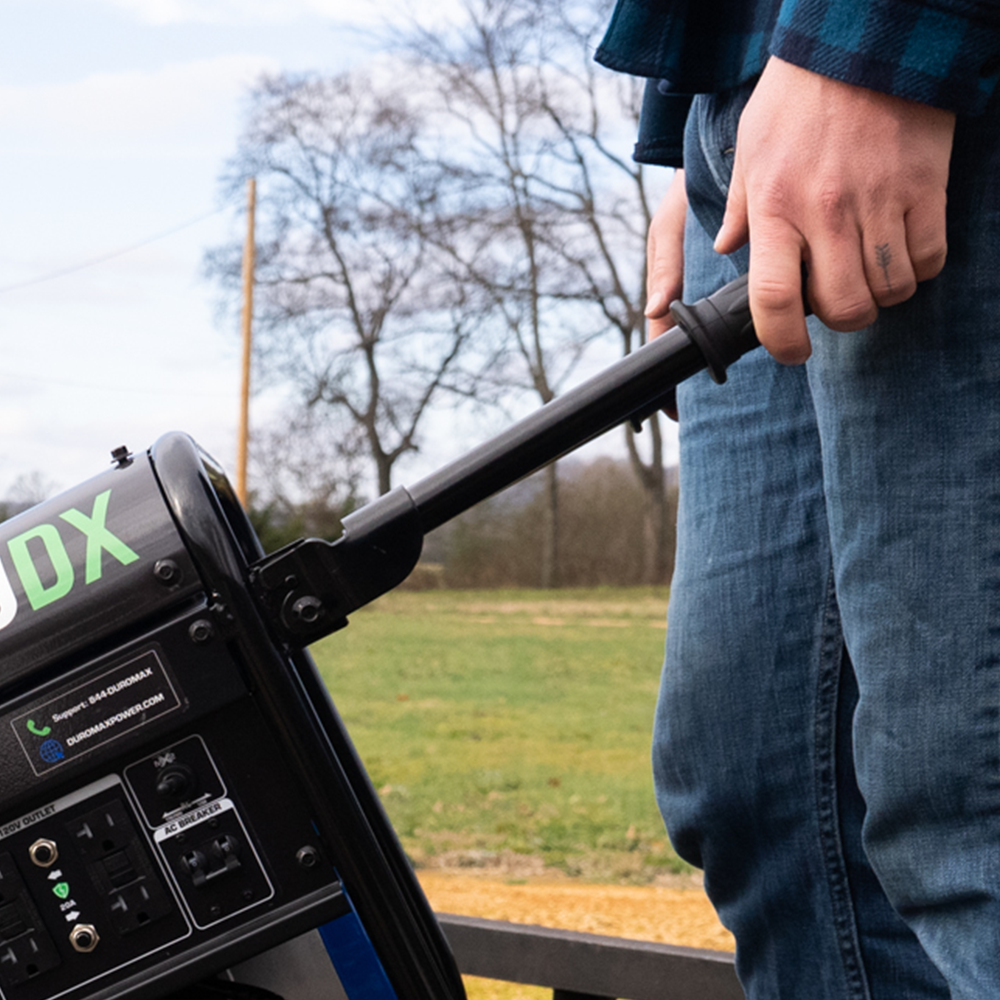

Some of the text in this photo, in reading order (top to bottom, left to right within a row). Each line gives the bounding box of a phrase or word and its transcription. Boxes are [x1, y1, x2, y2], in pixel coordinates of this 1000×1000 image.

[51, 667, 153, 723] Support: 844-DUROMAX
[66, 693, 165, 747] DUROMAXPOWER.COM
[21, 803, 56, 825] OUTLET
[163, 823, 177, 834] AC
[178, 801, 221, 828] BREAKER
